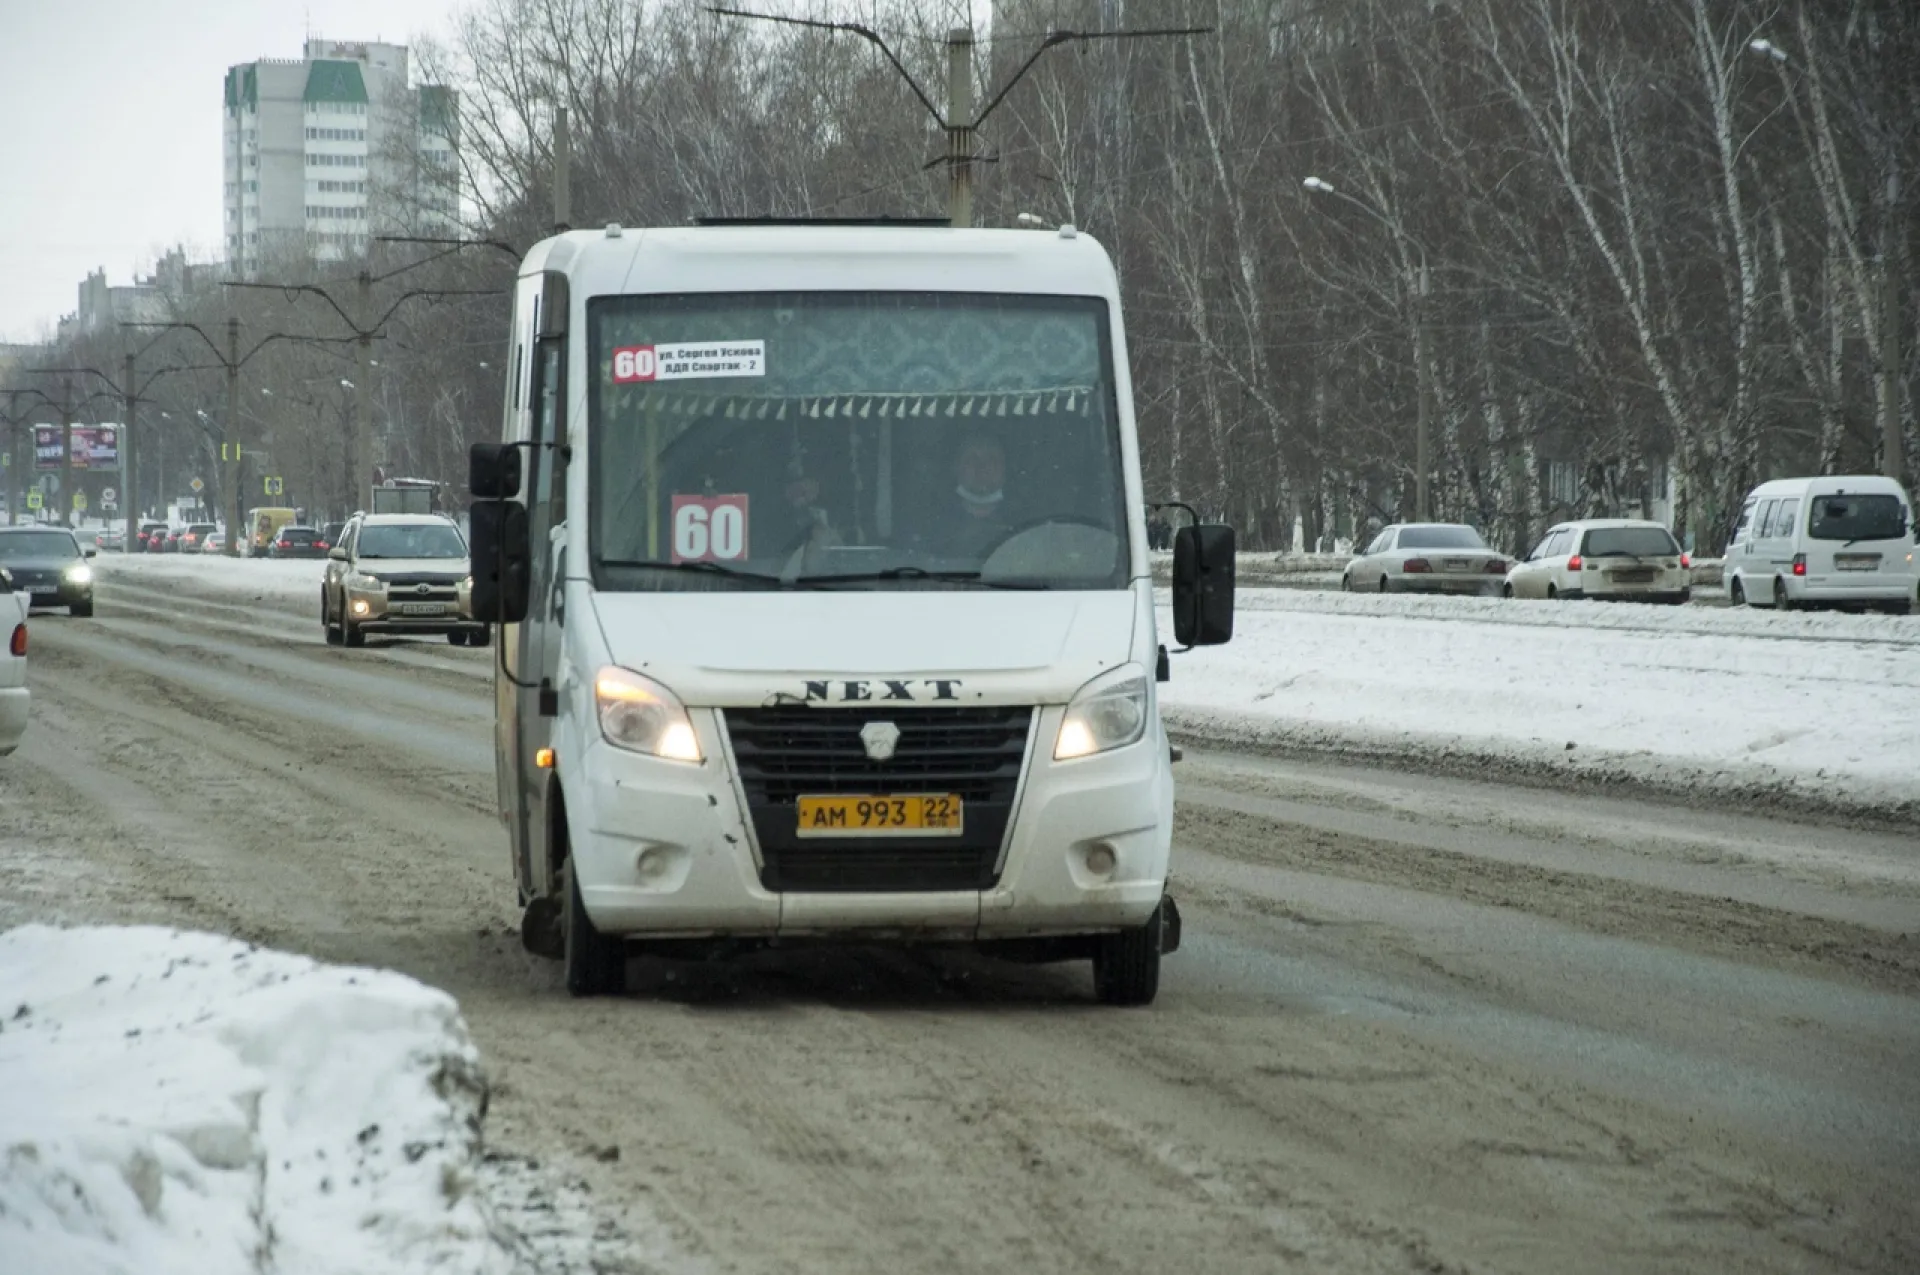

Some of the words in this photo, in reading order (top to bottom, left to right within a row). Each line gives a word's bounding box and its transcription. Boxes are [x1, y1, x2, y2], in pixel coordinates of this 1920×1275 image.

[615, 350, 655, 378] 60
[719, 348, 760, 358] Ускова
[691, 362, 741, 373] Спартак
[750, 359, 757, 370] 2
[676, 504, 743, 559] 60
[801, 679, 963, 701] NEXT
[856, 800, 906, 826] 993
[924, 798, 951, 819] 22
